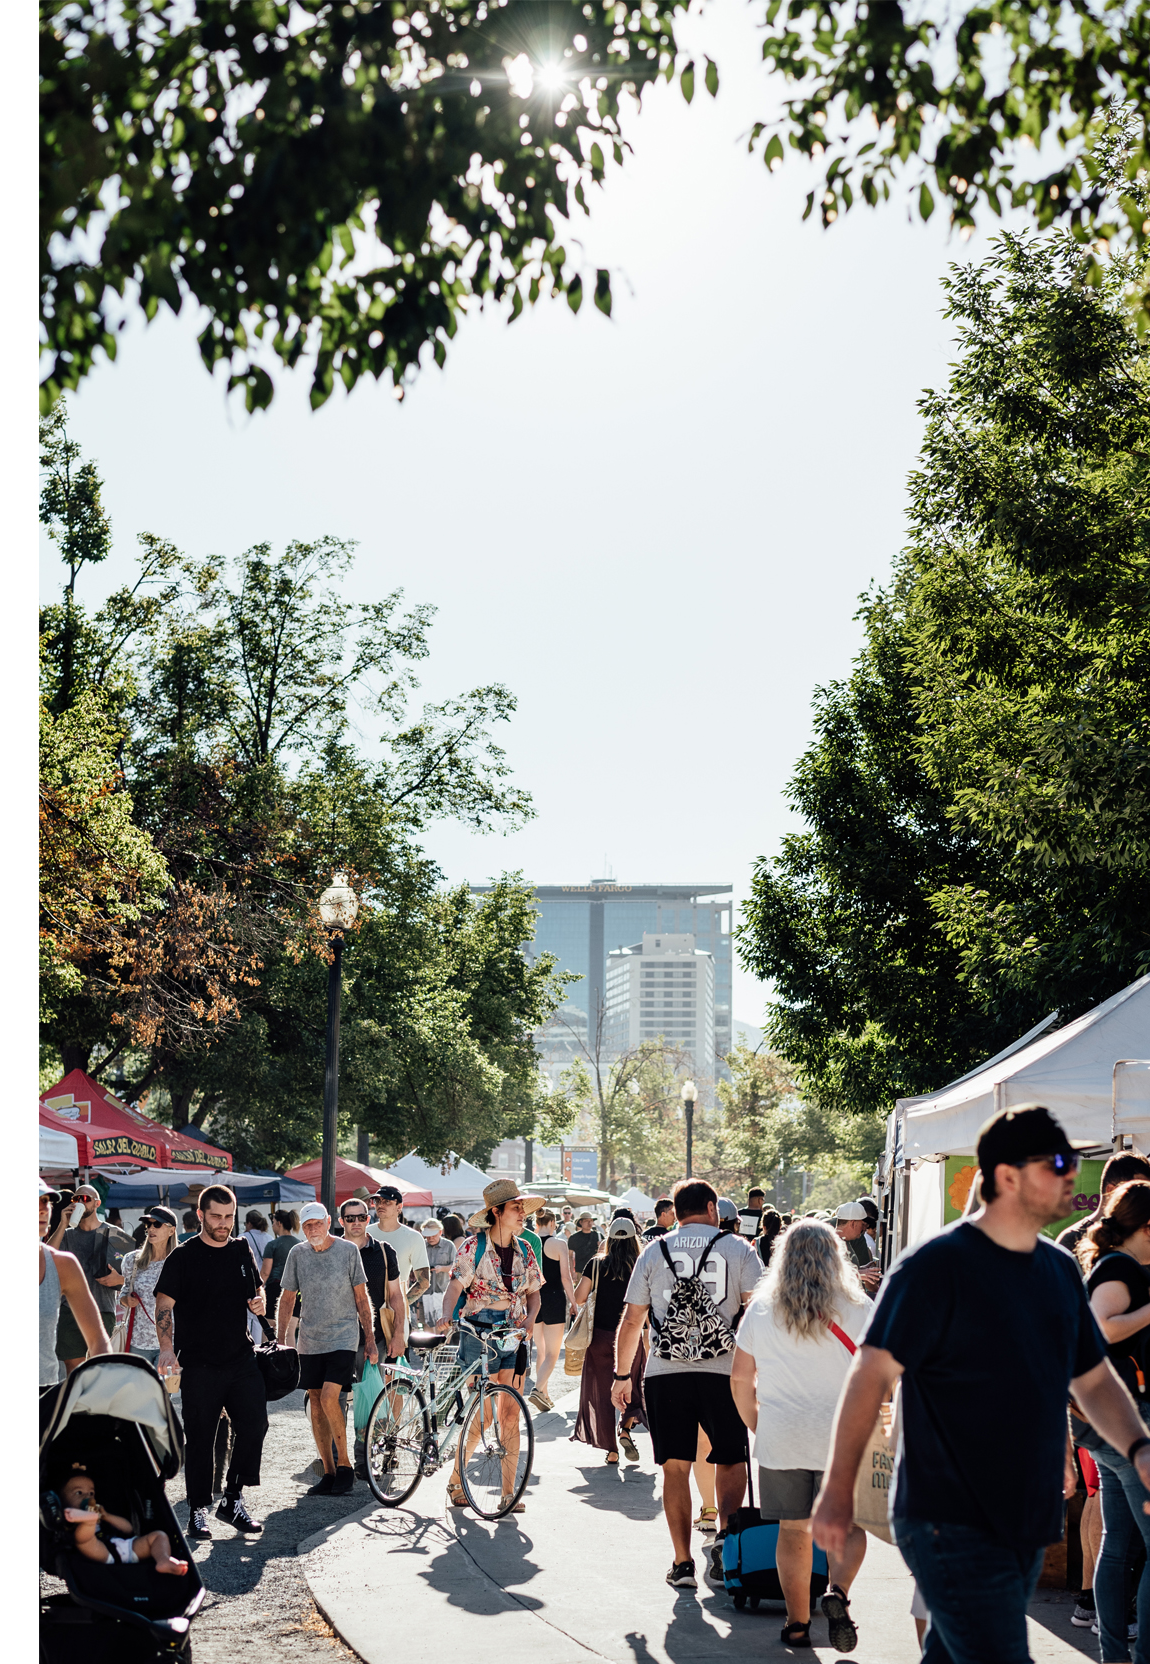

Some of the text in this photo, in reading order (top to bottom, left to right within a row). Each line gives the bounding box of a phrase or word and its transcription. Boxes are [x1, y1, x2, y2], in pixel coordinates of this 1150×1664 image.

[598, 884, 632, 892] FARGO
[93, 1137, 156, 1160] SALSA DEL DIABLO
[194, 1149, 207, 1164] DEL
[673, 1236, 716, 1249] ARIZON
